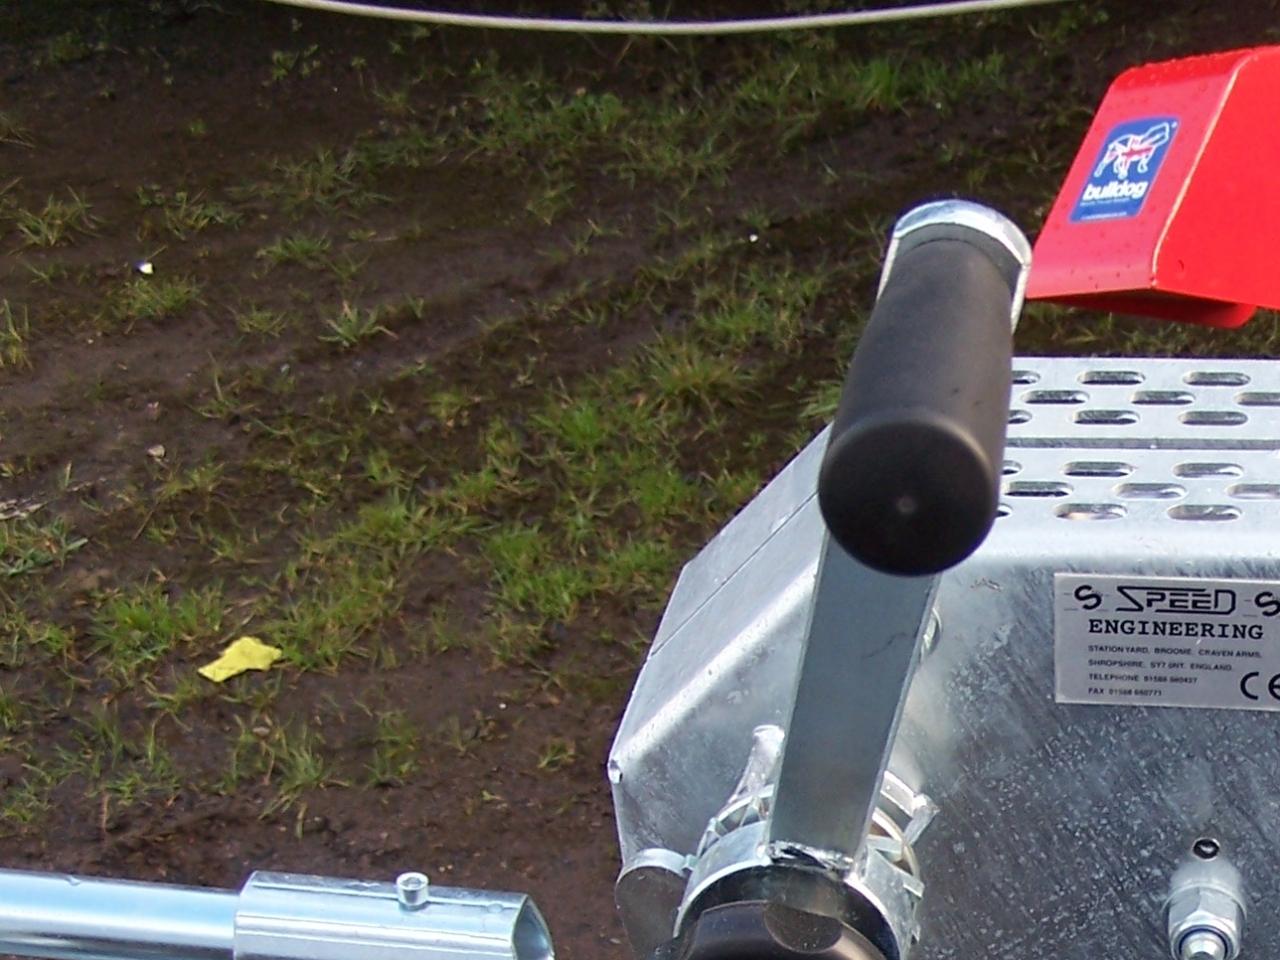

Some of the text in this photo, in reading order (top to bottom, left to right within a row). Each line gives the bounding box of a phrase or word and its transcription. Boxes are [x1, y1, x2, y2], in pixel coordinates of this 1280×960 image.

[1082, 180, 1149, 201] bulldog
[1088, 618, 1264, 640] ENGINEERING
[1088, 645, 1124, 653] STATION
[1198, 649, 1234, 657] CRAVEN
[1088, 673, 1140, 682] TELEPHONE
[1088, 687, 1105, 695] FAX
